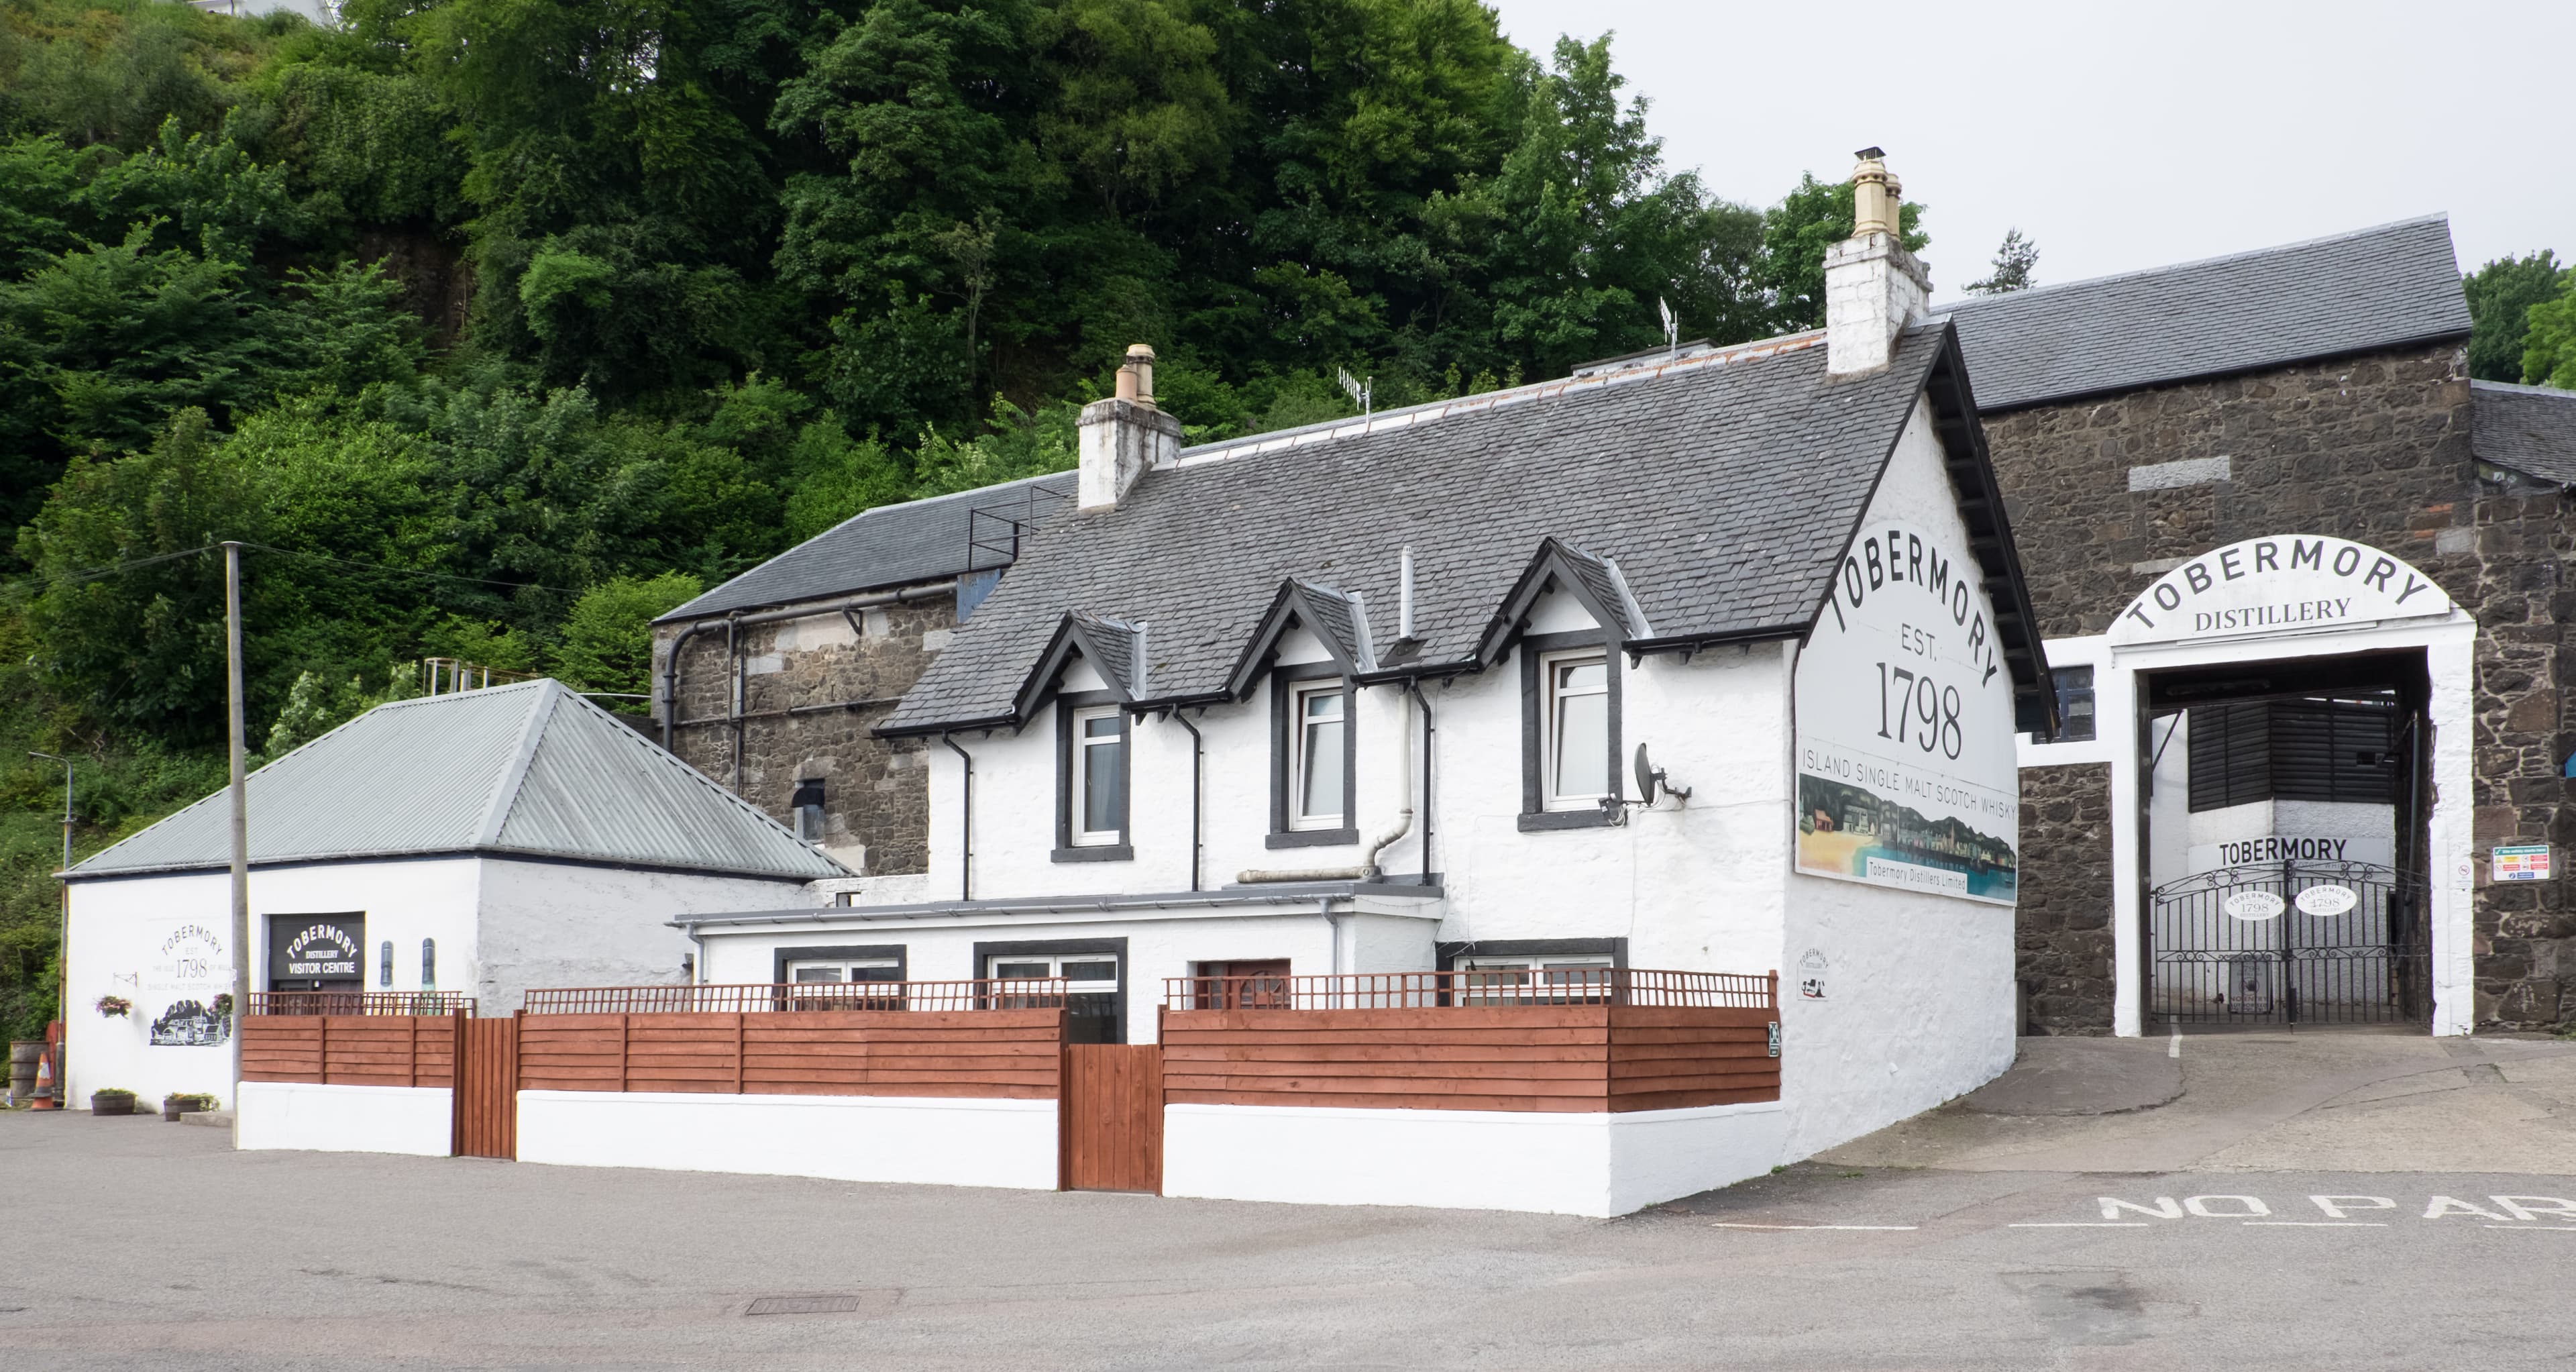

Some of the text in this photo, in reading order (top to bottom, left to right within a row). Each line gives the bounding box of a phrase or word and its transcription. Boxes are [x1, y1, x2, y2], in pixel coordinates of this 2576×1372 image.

[2126, 539, 2428, 629] TOBERMORY
[1826, 530, 1998, 689] TOBERMORY
[2195, 597, 2351, 632] DISTILLERY
[1902, 623, 1937, 662] EST.
[1876, 662, 1962, 760] 1798
[1803, 748, 2018, 821] ISLAND SINGLE MALT SCOTCH WHISKY
[2220, 837, 2347, 865] TOBERMORY
[1870, 861, 1966, 890] Tobermory Distillers Limited
[2230, 893, 2280, 906] TOBERMORY
[2242, 903, 2269, 913] 1798
[2301, 887, 2351, 902] TOBERMORY
[162, 925, 223, 955] TOBERMORY
[286, 925, 358, 959] TOBERMORY
[176, 958, 207, 978] 1798
[289, 961, 355, 974] VISITOR CENTRE
[306, 950, 339, 959] DISTILLERY
[1800, 948, 1829, 969] TOBERMORY
[2098, 1195, 2271, 1220] NO
